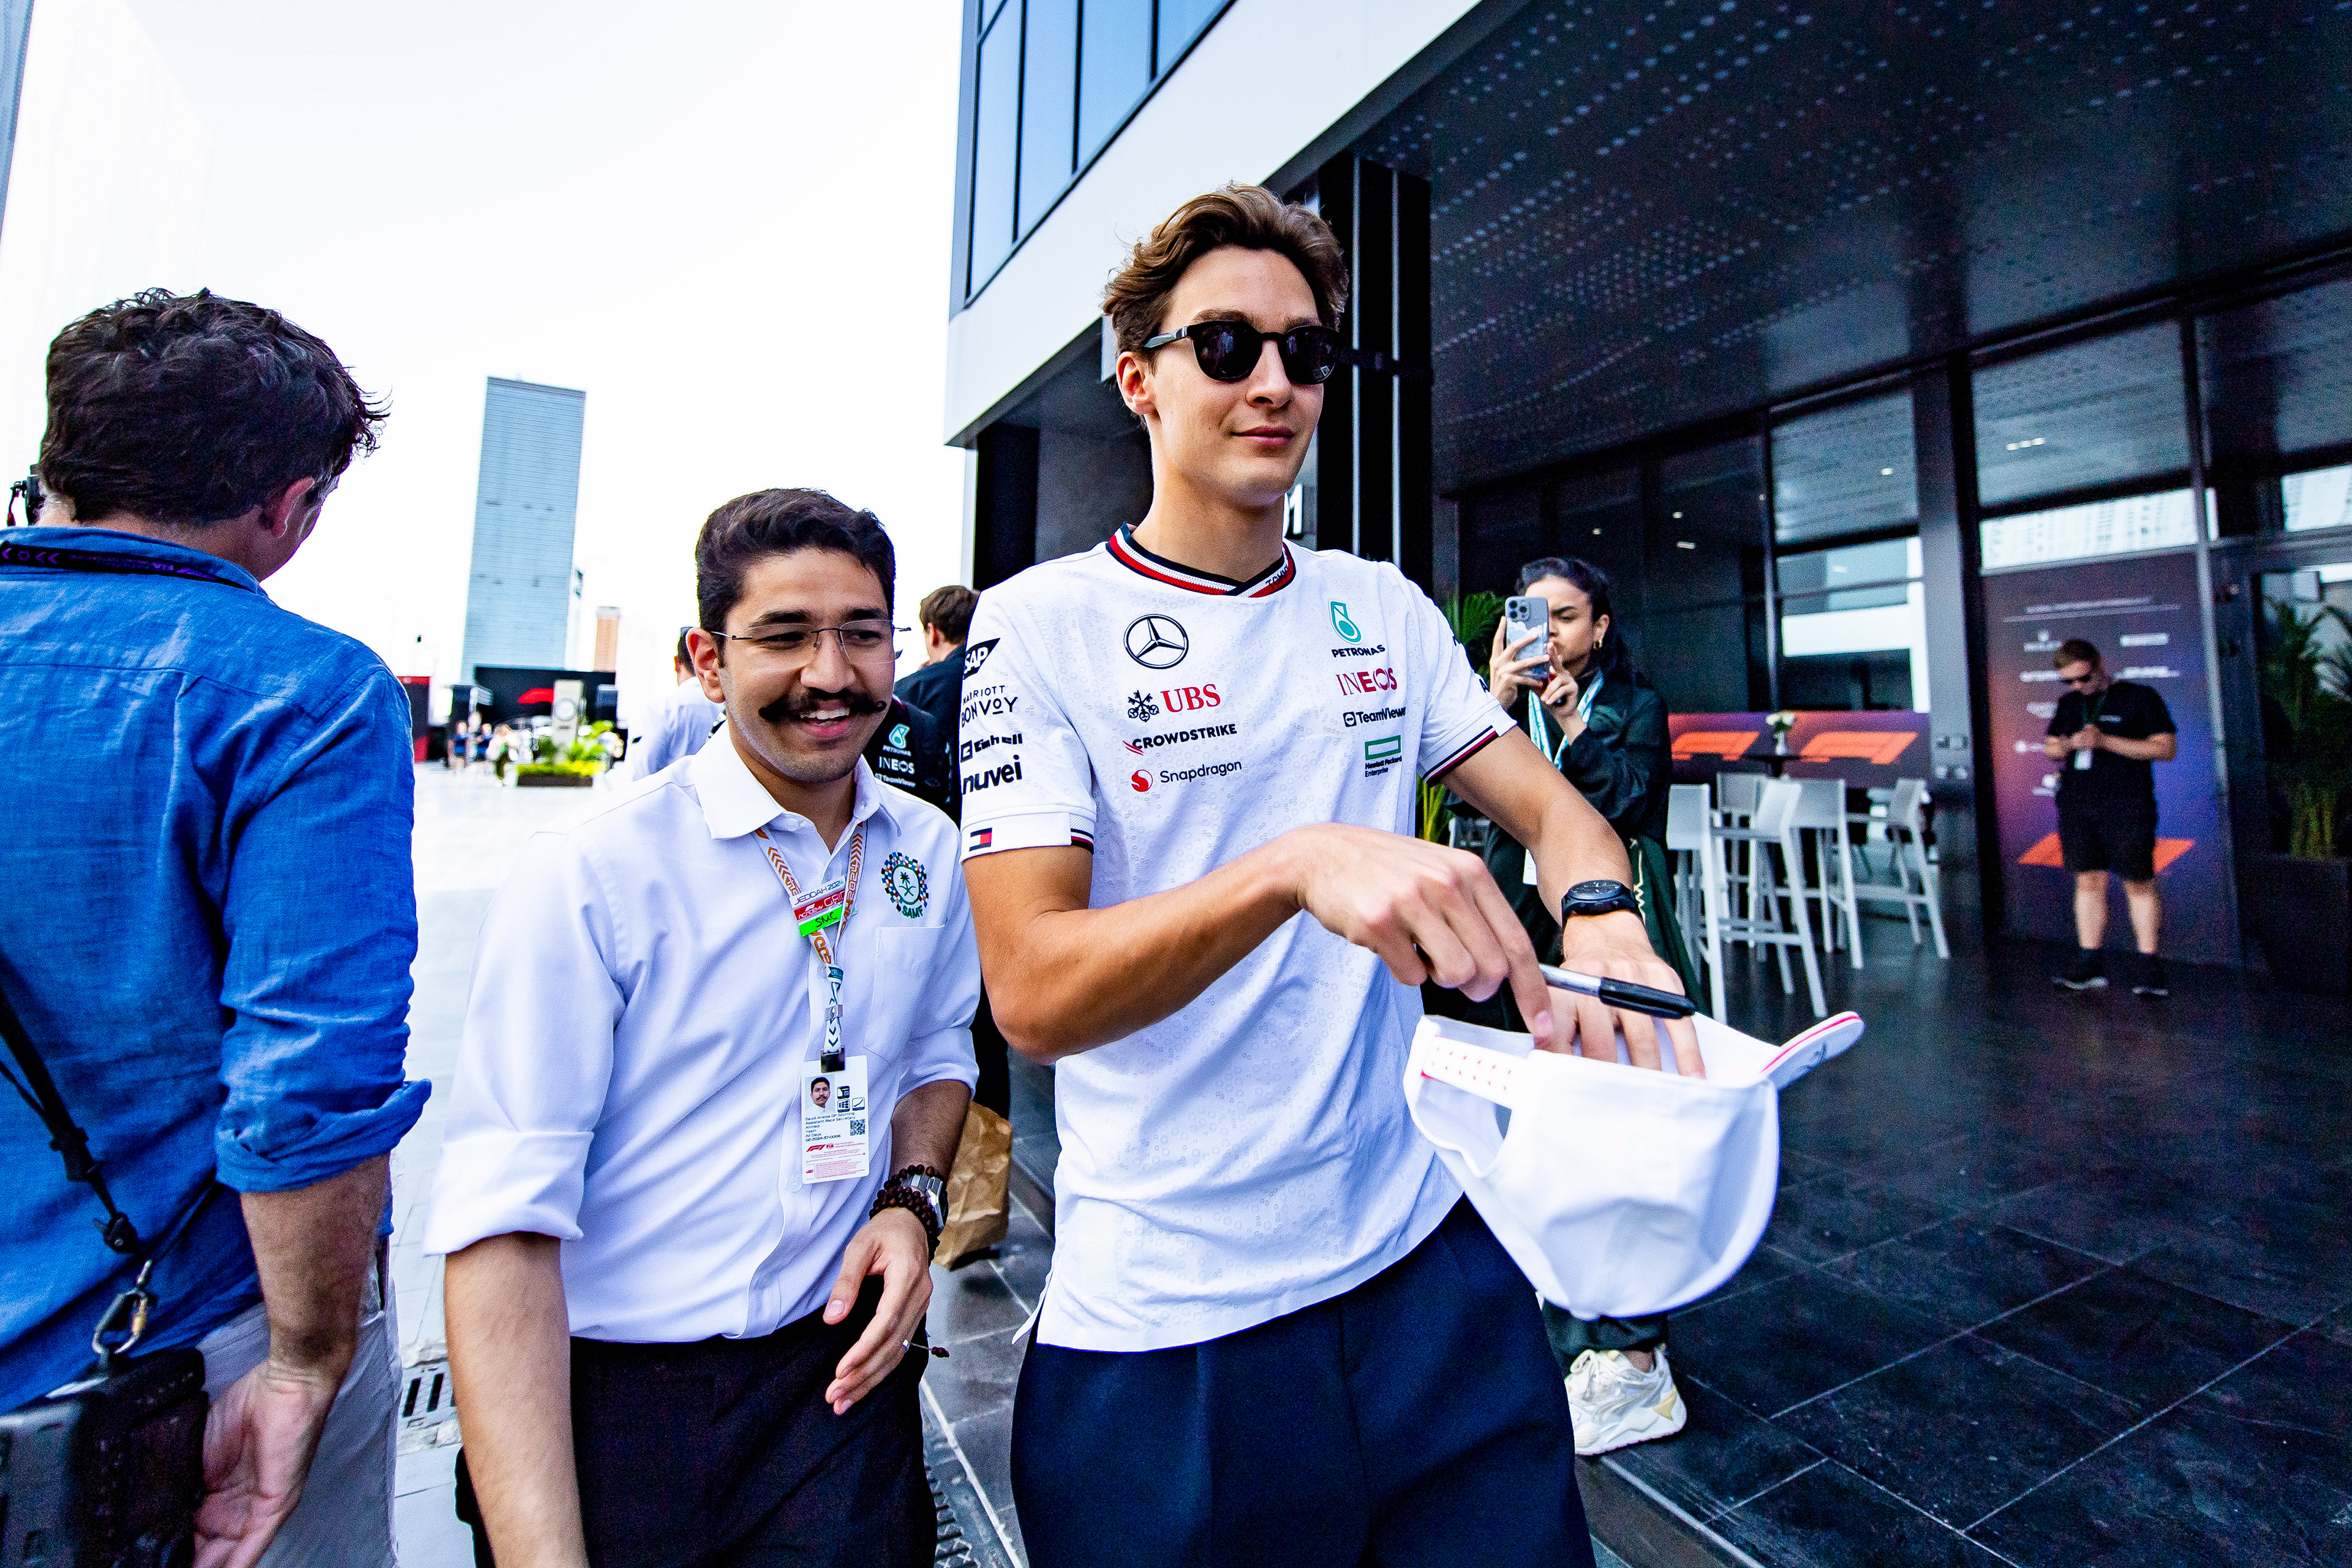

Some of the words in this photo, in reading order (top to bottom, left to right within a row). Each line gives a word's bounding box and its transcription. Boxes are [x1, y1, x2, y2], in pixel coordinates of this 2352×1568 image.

[1283, 483, 1303, 538] 1
[964, 647, 989, 674] SAP
[1332, 644, 1385, 658] PETRONAS
[1336, 667, 1398, 696] INEOS
[1161, 684, 1221, 712] UBS
[962, 696, 1018, 728] BONVOY
[1131, 723, 1237, 749] CROWDSTRIKE
[879, 756, 916, 775] INEOS
[962, 755, 1022, 795] nuvei
[1160, 761, 1242, 783] Snapdragon
[1365, 767, 1389, 777] Enterprise
[794, 886, 827, 905] JEDDAH
[815, 912, 838, 927] SMC
